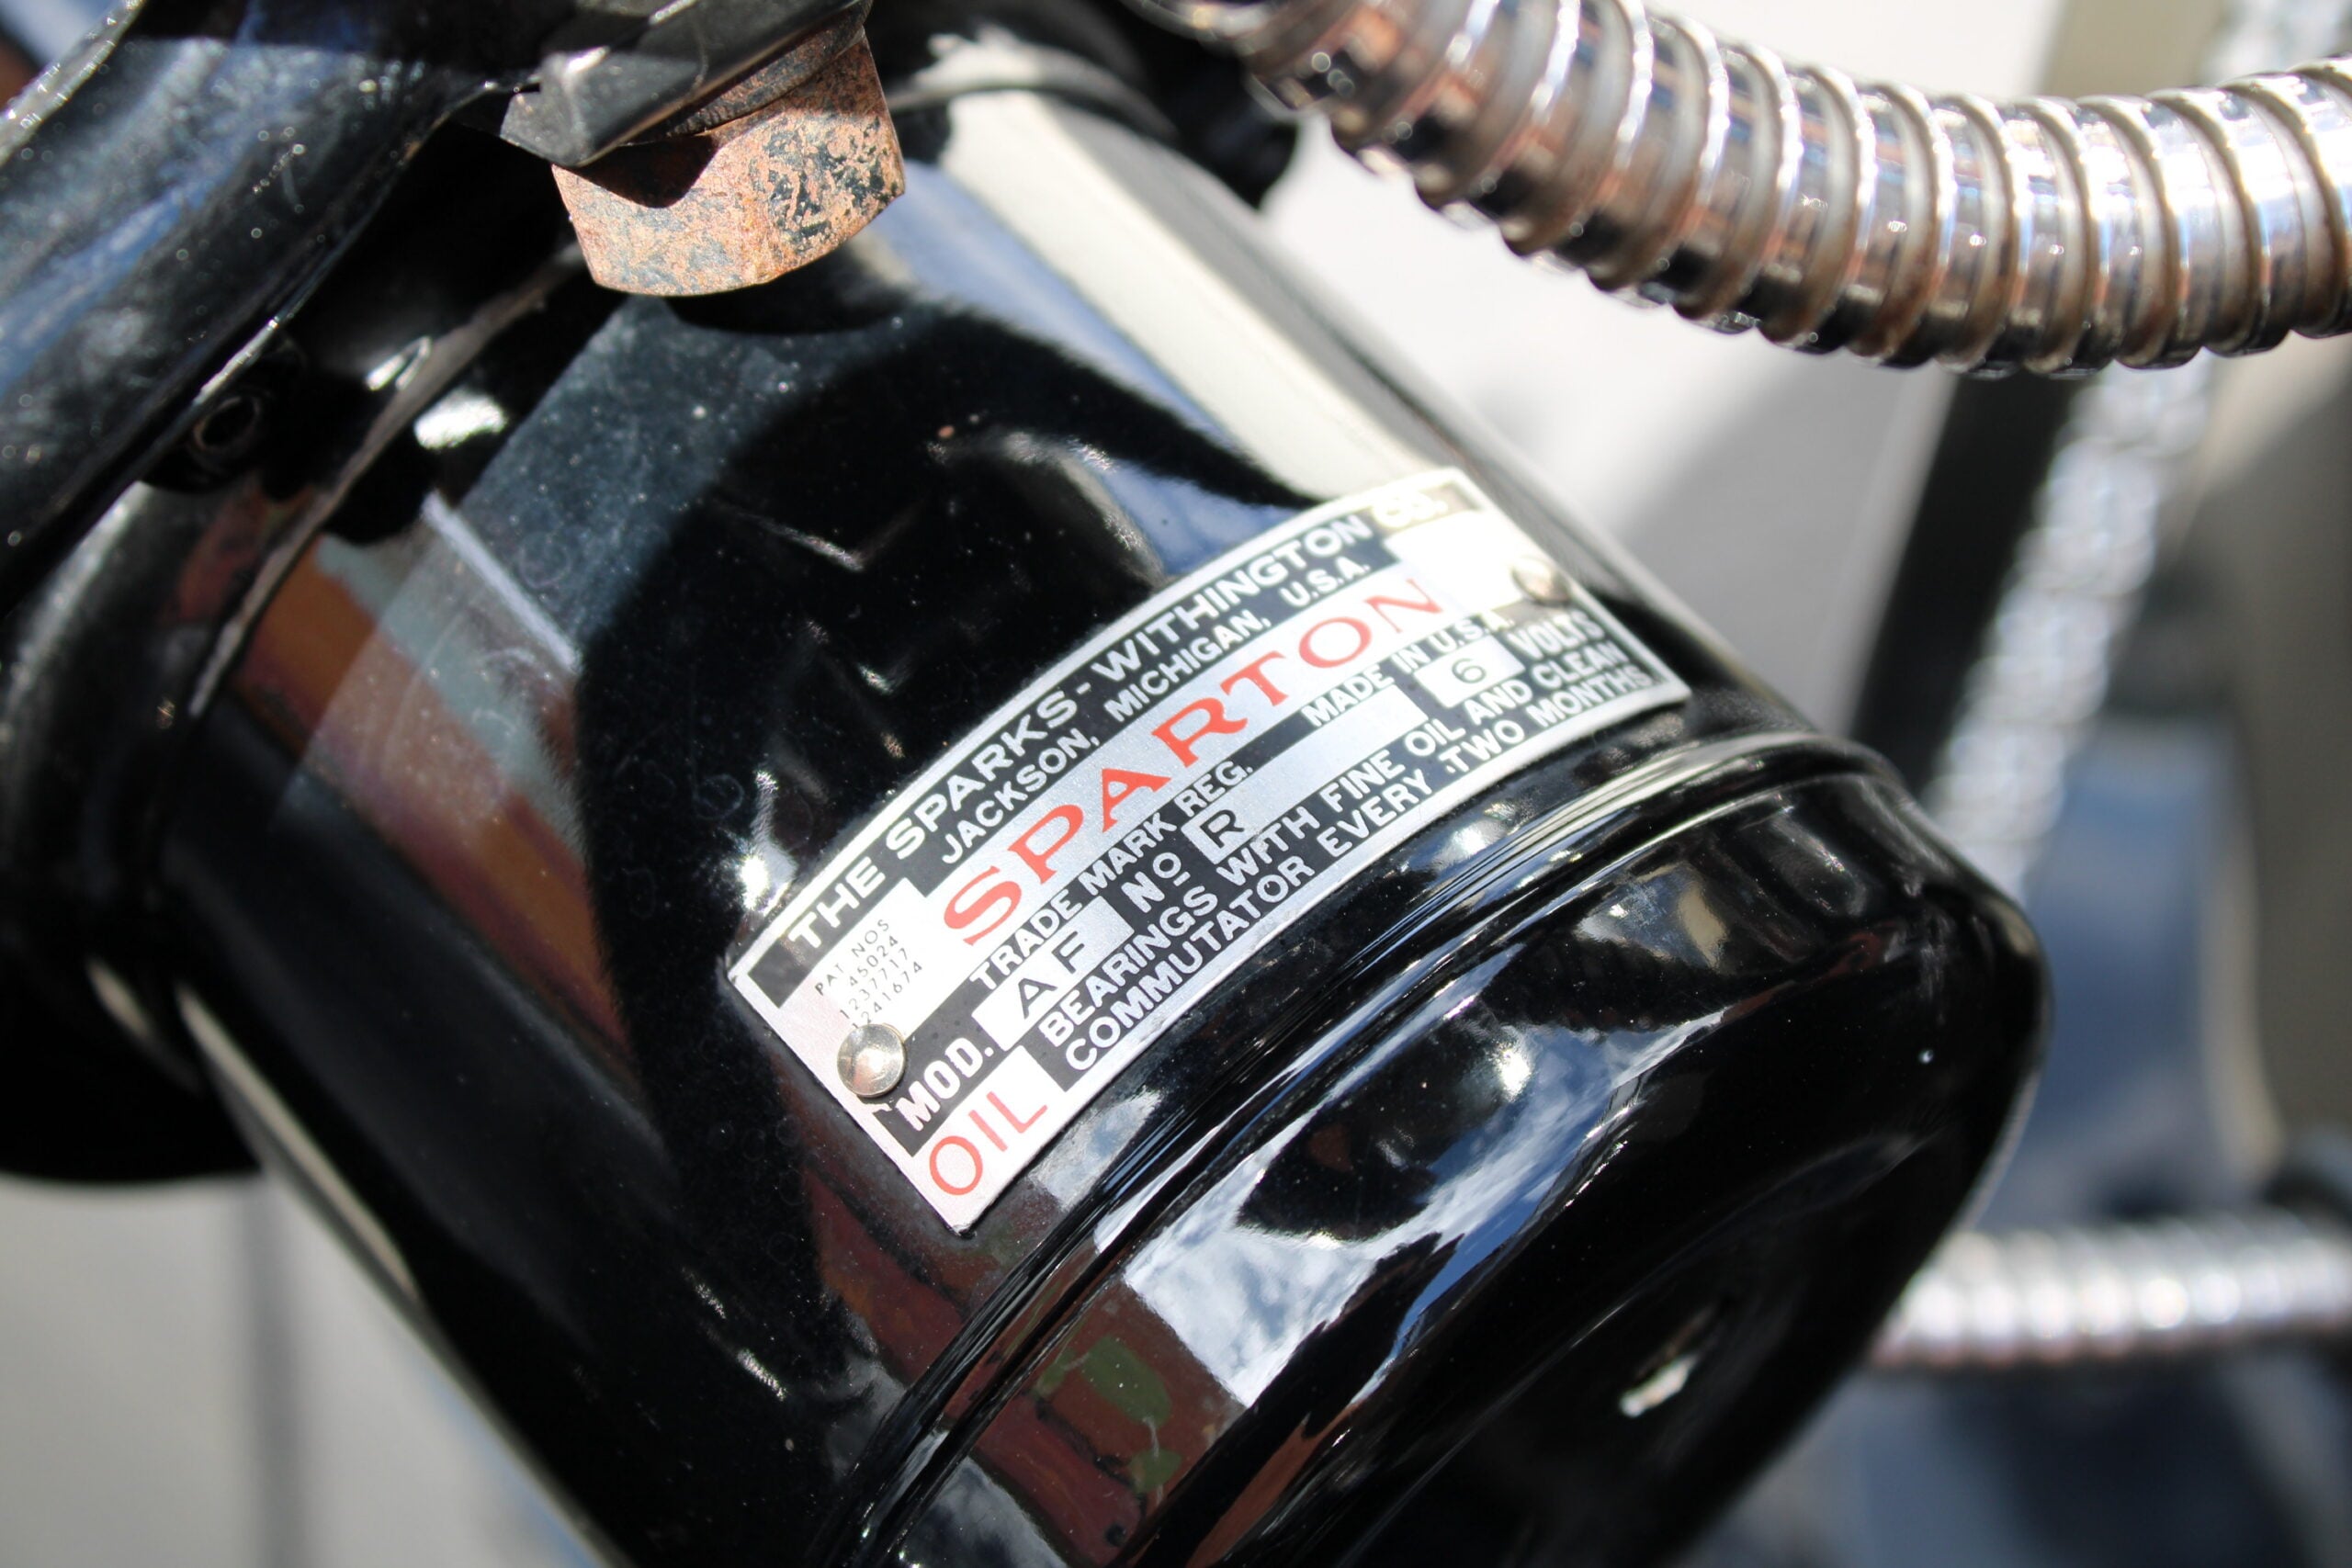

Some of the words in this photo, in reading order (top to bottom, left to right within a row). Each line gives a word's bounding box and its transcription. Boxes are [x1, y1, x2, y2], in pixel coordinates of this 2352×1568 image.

[1301, 660, 1395, 728] MADE
[1396, 644, 1430, 675] IN
[1451, 657, 1487, 685] 6
[1507, 610, 1605, 660] VOLTS
[942, 728, 1100, 865] JACKSON,
[1104, 608, 1272, 723] MICHIGAN,
[944, 578, 1442, 947] SPARTON
[969, 888, 1083, 990] TRADE
[1079, 812, 1177, 897] MARK
[1174, 760, 1253, 818] REG.
[1038, 885, 1218, 1047] BEARINGS
[1217, 807, 1320, 887] WITH
[1320, 750, 1406, 814] FINE
[1406, 713, 1465, 760] OIL
[1464, 678, 1533, 726] AND
[1532, 640, 1630, 690] CLEAN
[1065, 855, 1315, 1072] COMMUTATOR
[1317, 771, 1433, 859] EVERY
[1439, 719, 1526, 775] TWO
[789, 857, 885, 949] THE
[814, 963, 844, 997] PAT
[851, 919, 889, 958] NOS
[840, 947, 908, 1020] 1237717
[850, 935, 899, 987] 45024
[896, 1036, 994, 1132] MOD.
[1197, 808, 1246, 850] R
[929, 1091, 1048, 1196] OIL
